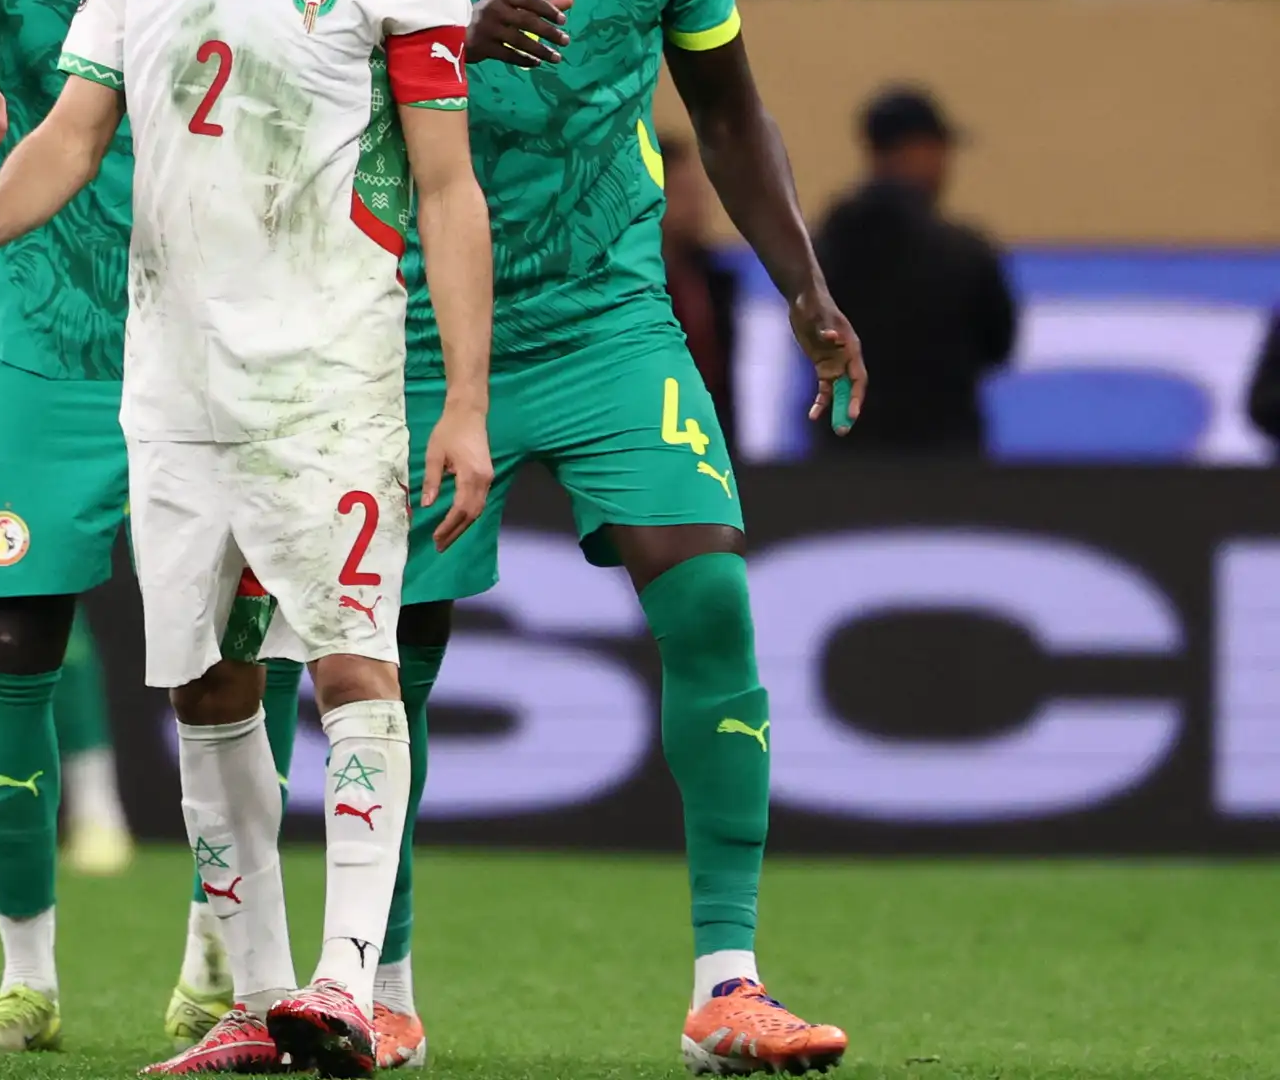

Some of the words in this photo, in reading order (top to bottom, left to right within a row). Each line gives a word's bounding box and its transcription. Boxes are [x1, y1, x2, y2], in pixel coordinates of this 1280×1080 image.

[189, 39, 233, 138] 2
[660, 377, 710, 456] 4
[336, 489, 382, 587] 2
